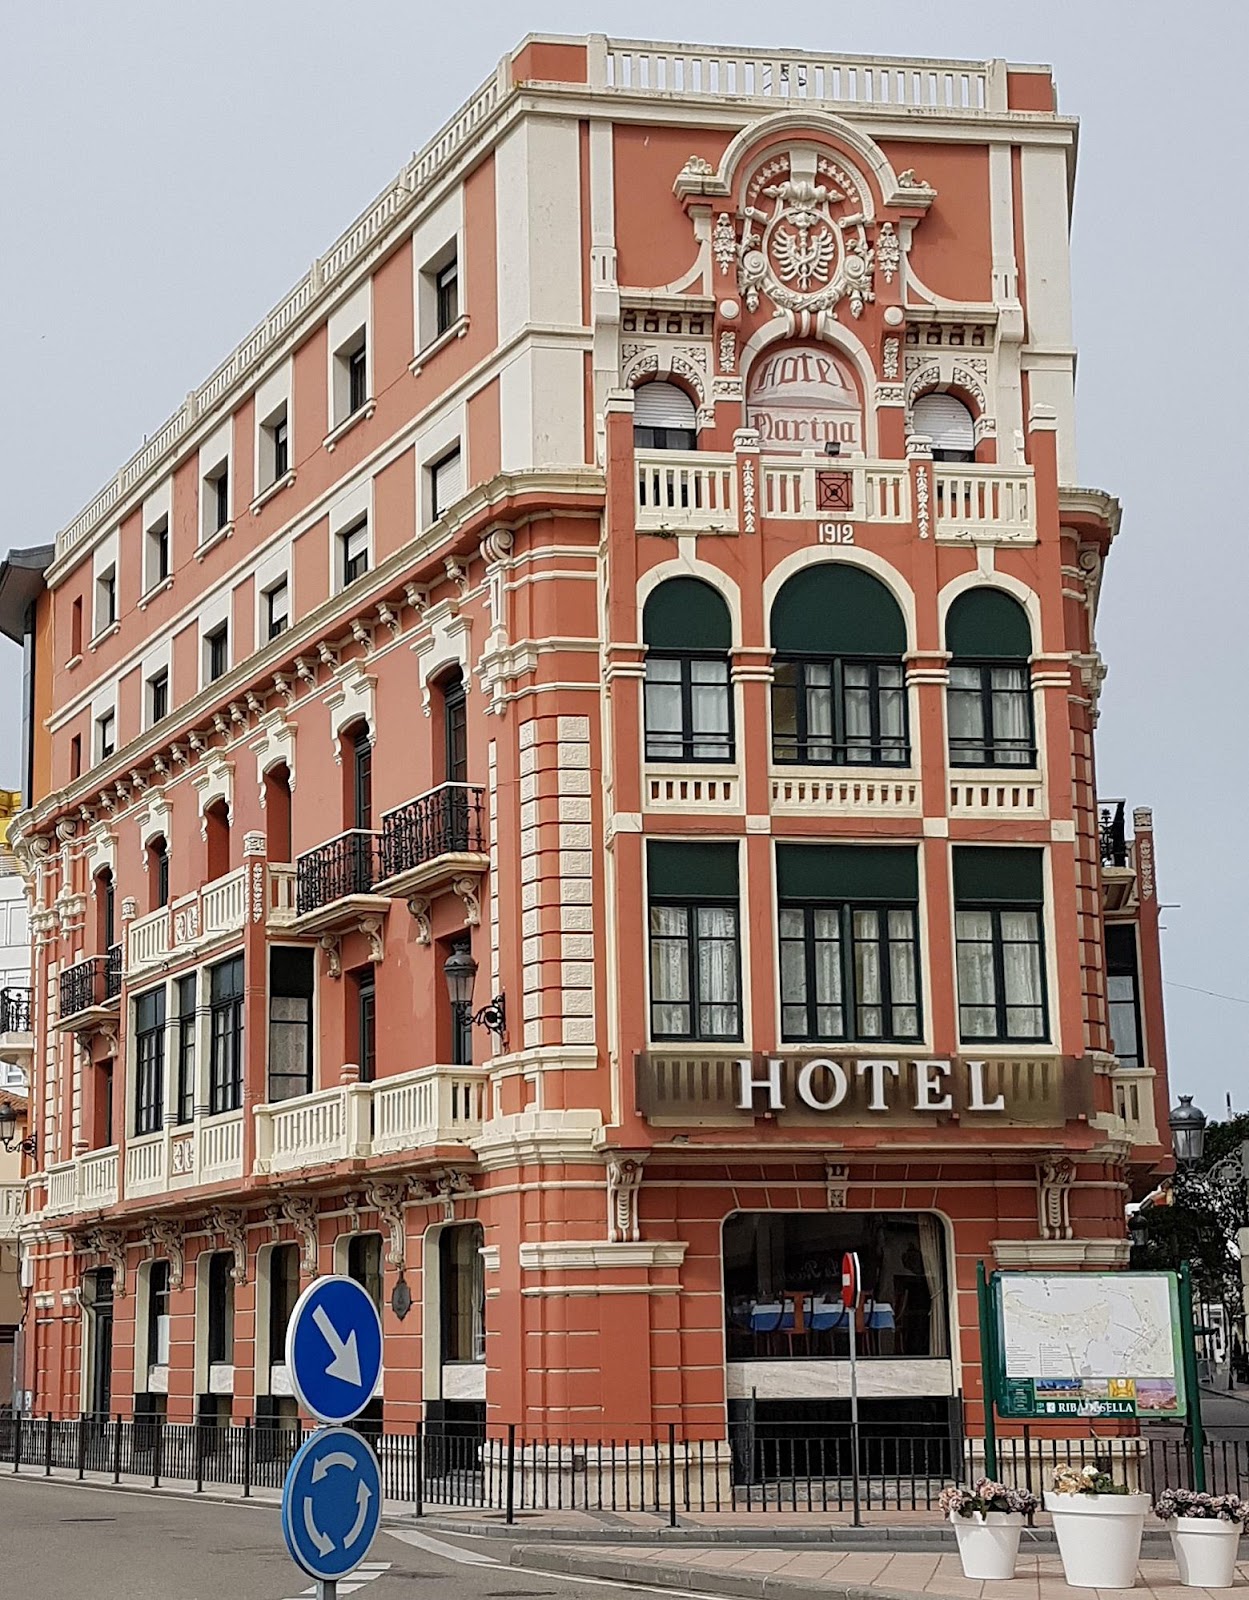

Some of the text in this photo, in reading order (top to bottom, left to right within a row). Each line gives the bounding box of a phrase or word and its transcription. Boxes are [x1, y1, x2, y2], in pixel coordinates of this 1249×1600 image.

[753, 353, 855, 394] Hotel
[818, 523, 854, 544] 1912
[736, 1058, 1005, 1111] HOTEL
